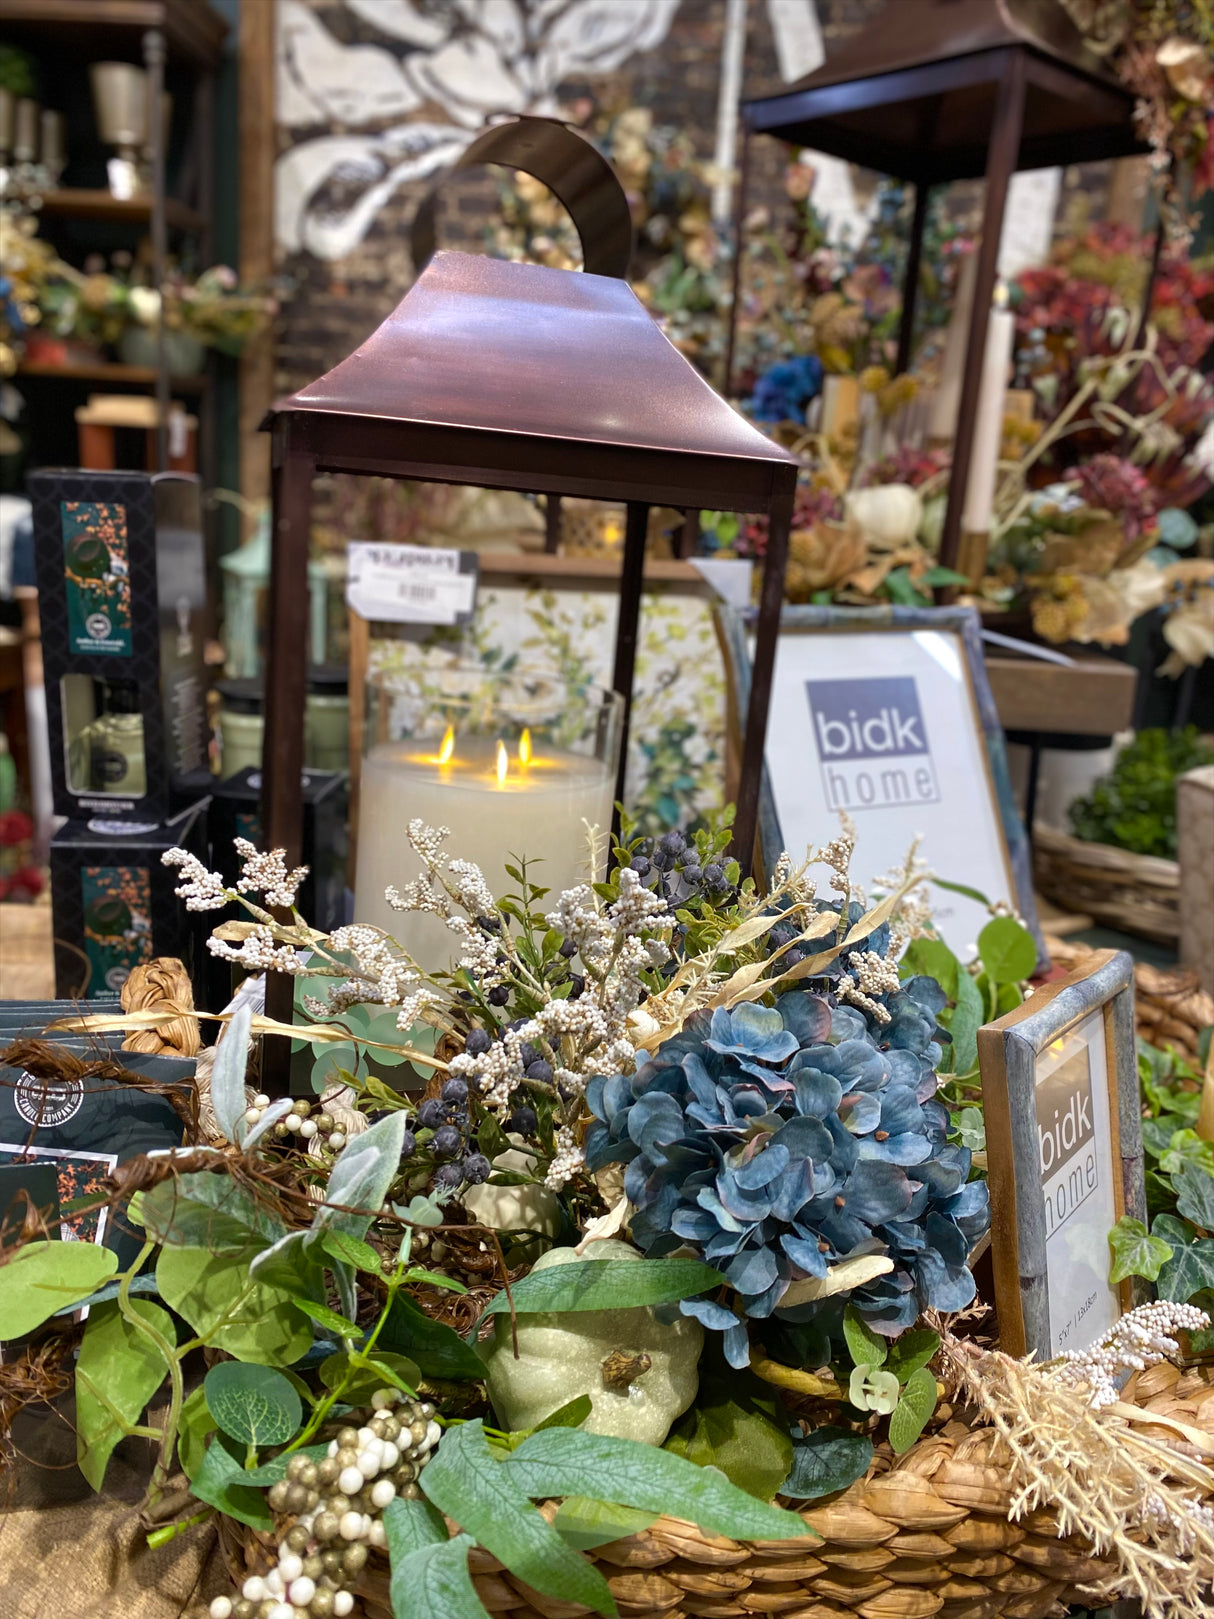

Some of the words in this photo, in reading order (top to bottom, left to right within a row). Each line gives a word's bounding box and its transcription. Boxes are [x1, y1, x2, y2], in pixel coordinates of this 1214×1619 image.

[816, 709, 923, 754] bidk
[828, 766, 934, 804] home
[42, 1103, 74, 1122] COMPANY
[1037, 1091, 1092, 1175] bidk
